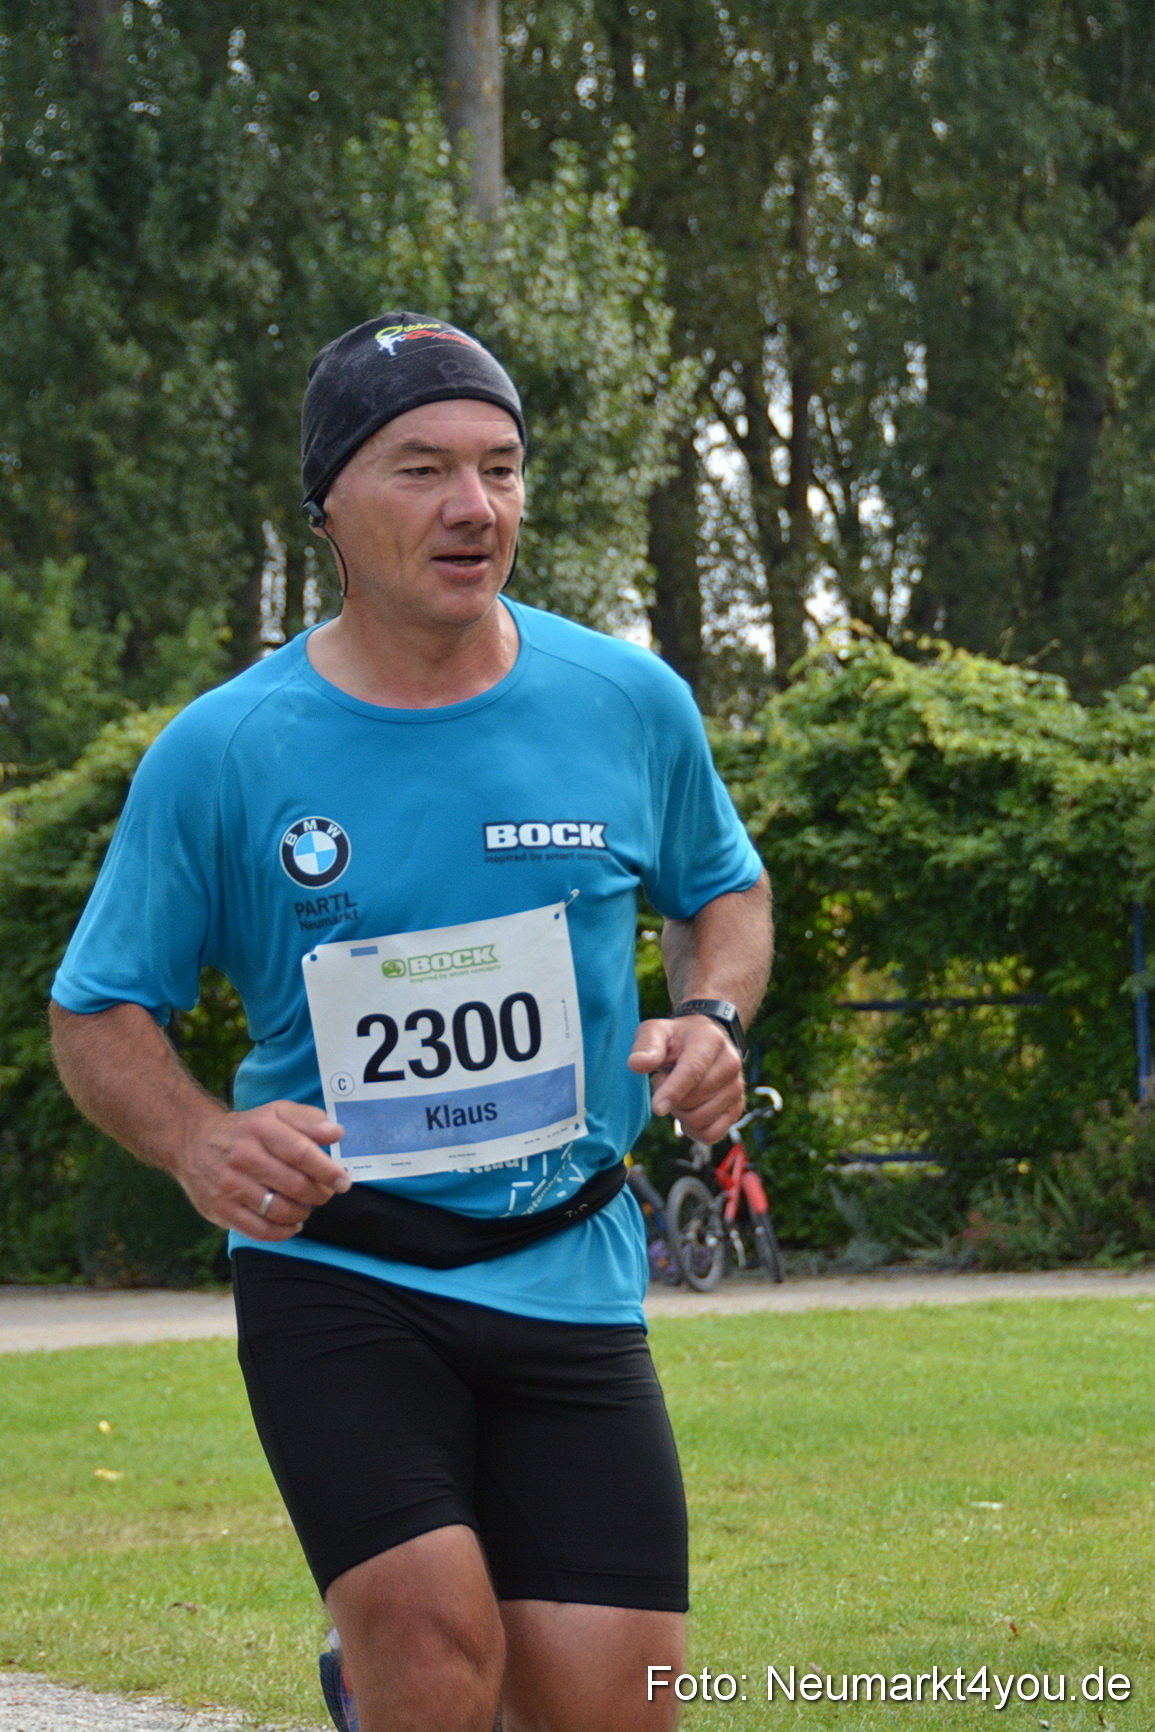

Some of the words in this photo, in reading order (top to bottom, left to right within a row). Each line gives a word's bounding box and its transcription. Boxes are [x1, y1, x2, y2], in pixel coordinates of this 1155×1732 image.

[285, 819, 341, 846] BMW
[484, 820, 608, 851] BOCK
[294, 892, 357, 918] PARTL
[300, 910, 359, 931] Neumarkt
[408, 944, 499, 976] BOCK
[356, 991, 542, 1084] 2300
[337, 1078, 347, 1092] C
[425, 1102, 498, 1130] Klaus
